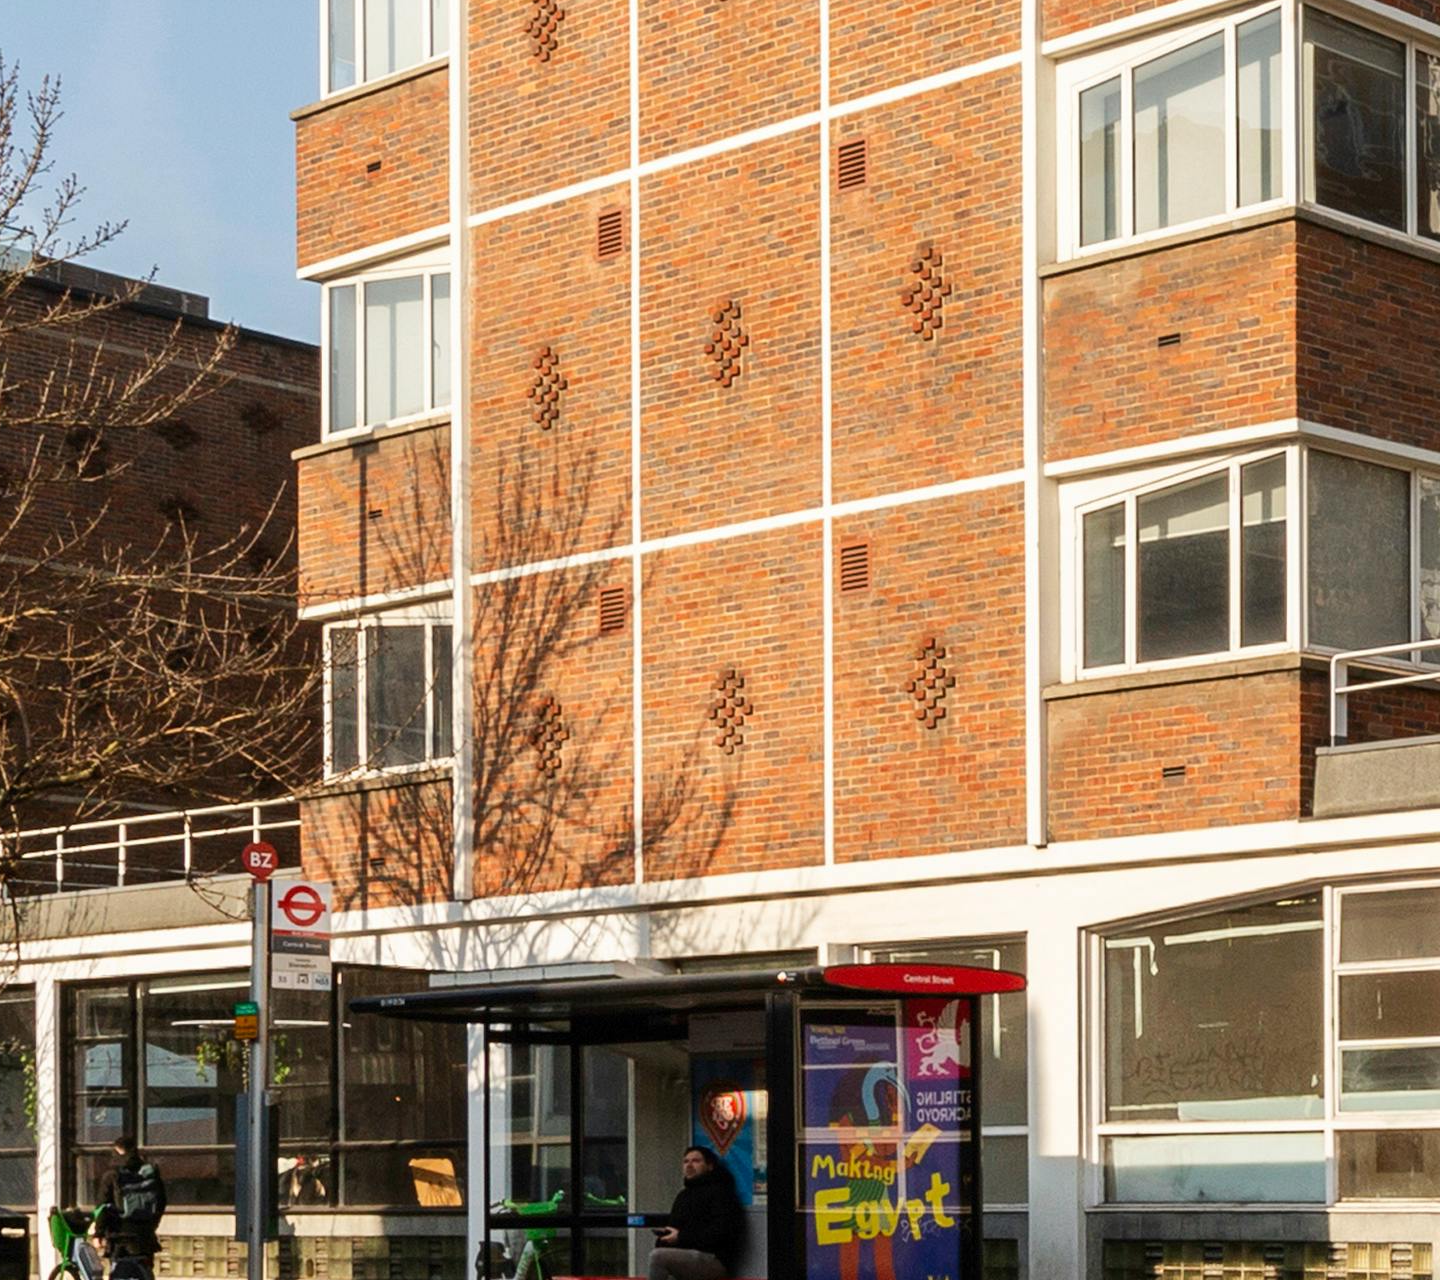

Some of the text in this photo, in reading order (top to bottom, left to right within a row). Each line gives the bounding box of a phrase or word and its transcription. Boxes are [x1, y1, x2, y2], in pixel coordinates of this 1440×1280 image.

[250, 852, 273, 868] BZ
[903, 973, 954, 985] Central Street
[811, 1151, 896, 1186] Making
[815, 1172, 955, 1245] Egypt
